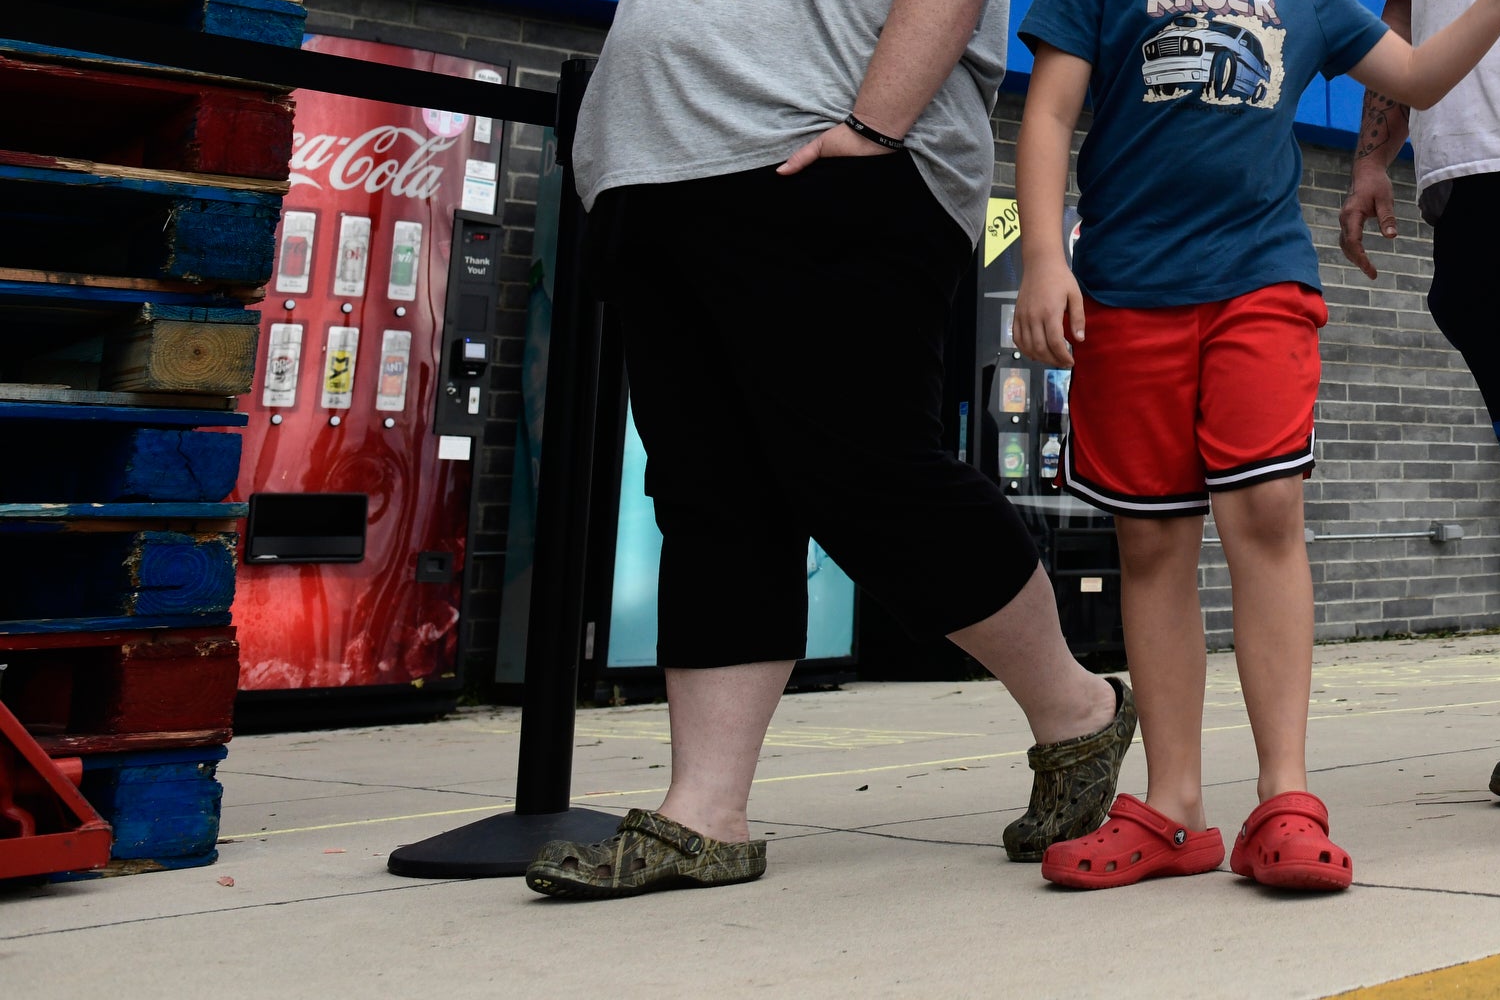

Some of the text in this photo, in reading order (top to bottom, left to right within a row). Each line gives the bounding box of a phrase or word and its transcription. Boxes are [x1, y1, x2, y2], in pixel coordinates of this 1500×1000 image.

[289, 126, 460, 200] ca-Cola
[464, 255, 490, 267] Thank
[467, 265, 486, 276] You!
